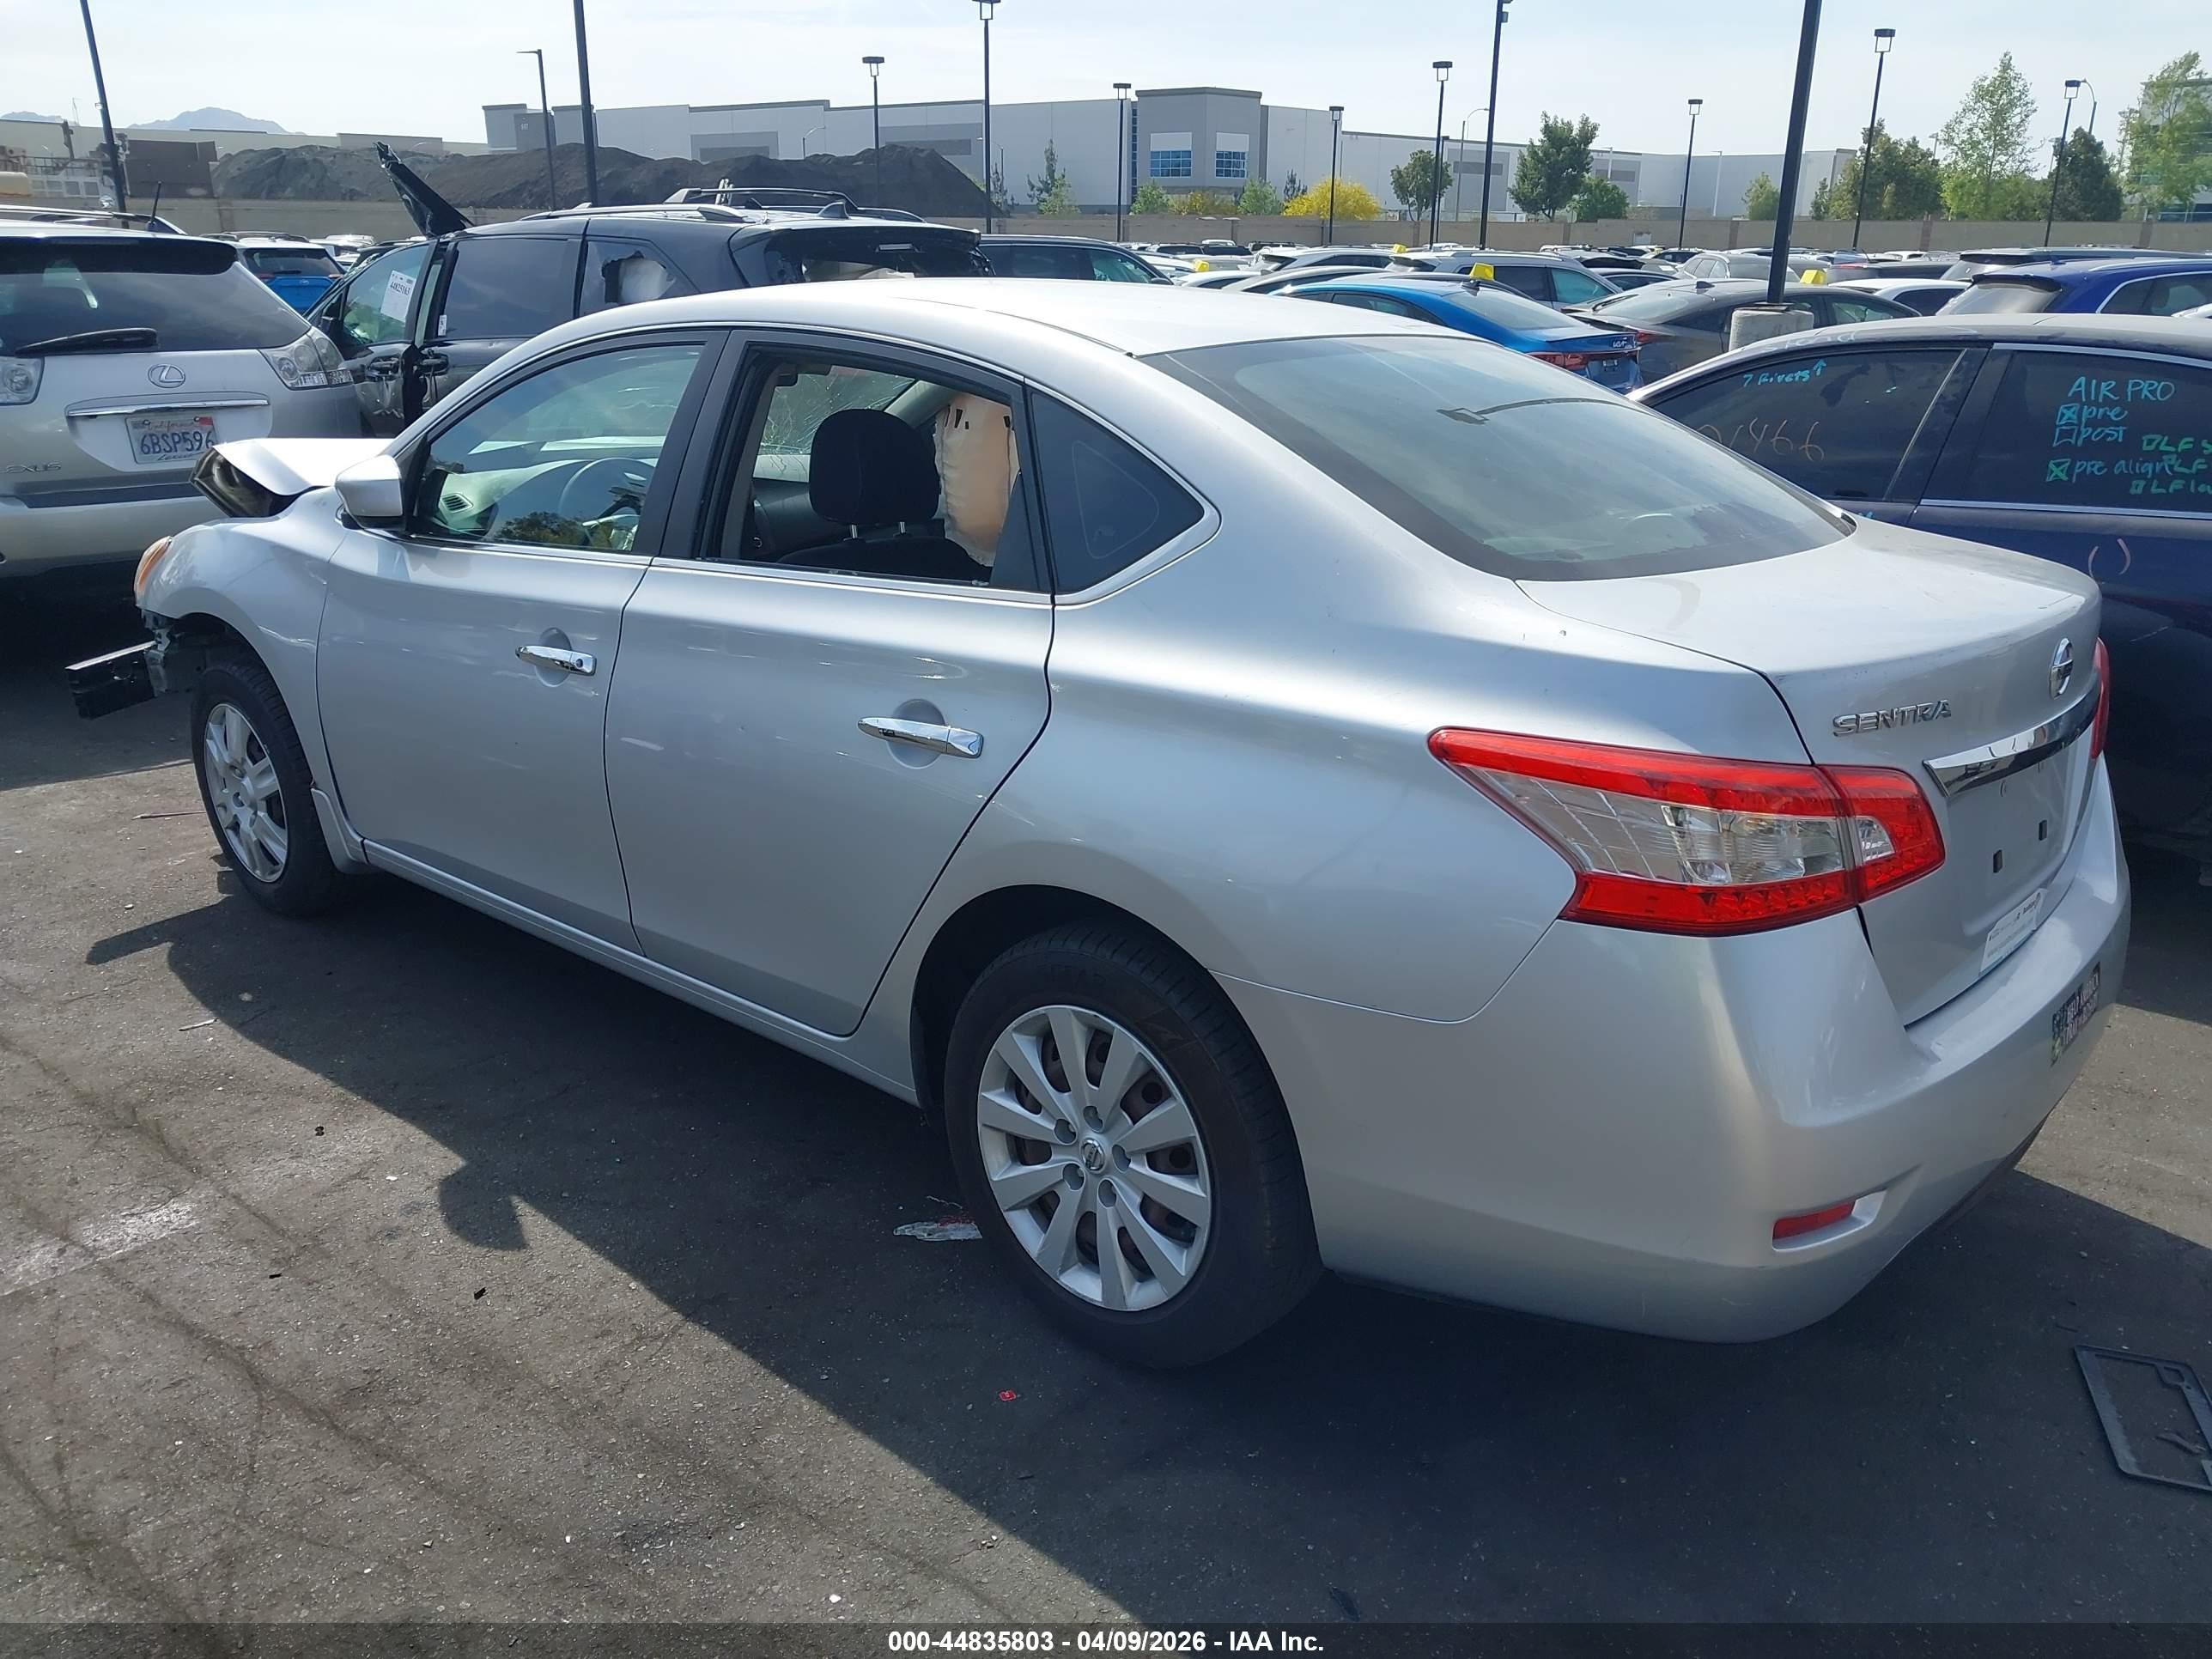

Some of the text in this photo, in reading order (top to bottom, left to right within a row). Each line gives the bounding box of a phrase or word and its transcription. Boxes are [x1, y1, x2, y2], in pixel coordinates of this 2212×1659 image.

[1743, 374, 1754, 386] 7
[2068, 376, 2175, 402] AIR PRO
[2081, 404, 2128, 427] pre
[141, 431, 214, 455] 6BSP596
[2077, 426, 2127, 447] post
[2114, 458, 2173, 478] align
[1832, 699, 1952, 737] SENTRA
